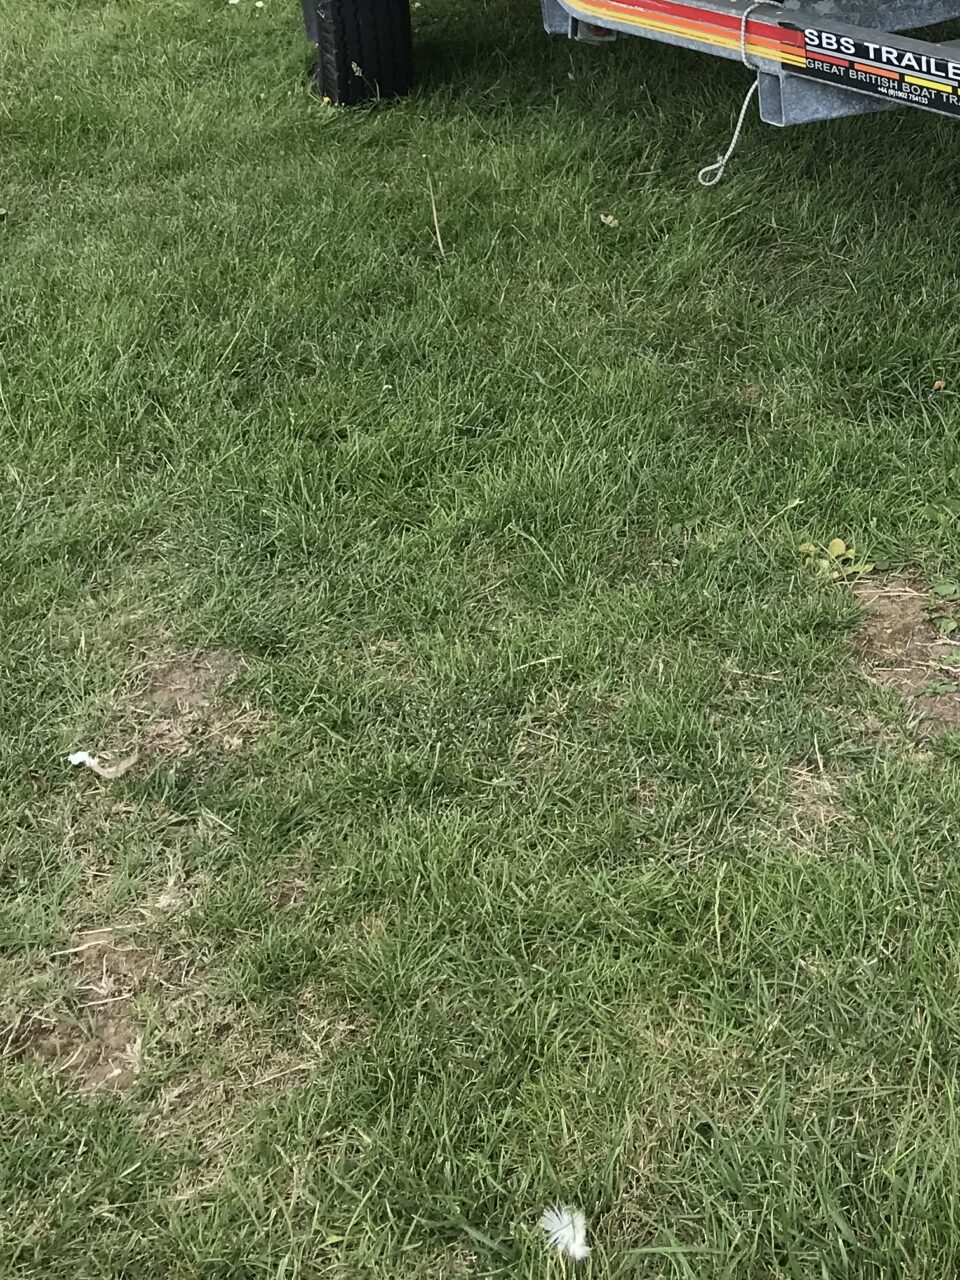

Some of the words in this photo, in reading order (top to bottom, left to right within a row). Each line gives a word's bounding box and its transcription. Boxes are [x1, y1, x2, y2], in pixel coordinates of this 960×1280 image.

[804, 28, 856, 54] SBS
[806, 59, 846, 76] GREAT
[849, 69, 898, 90] BRITISH
[902, 82, 937, 99] BOAT
